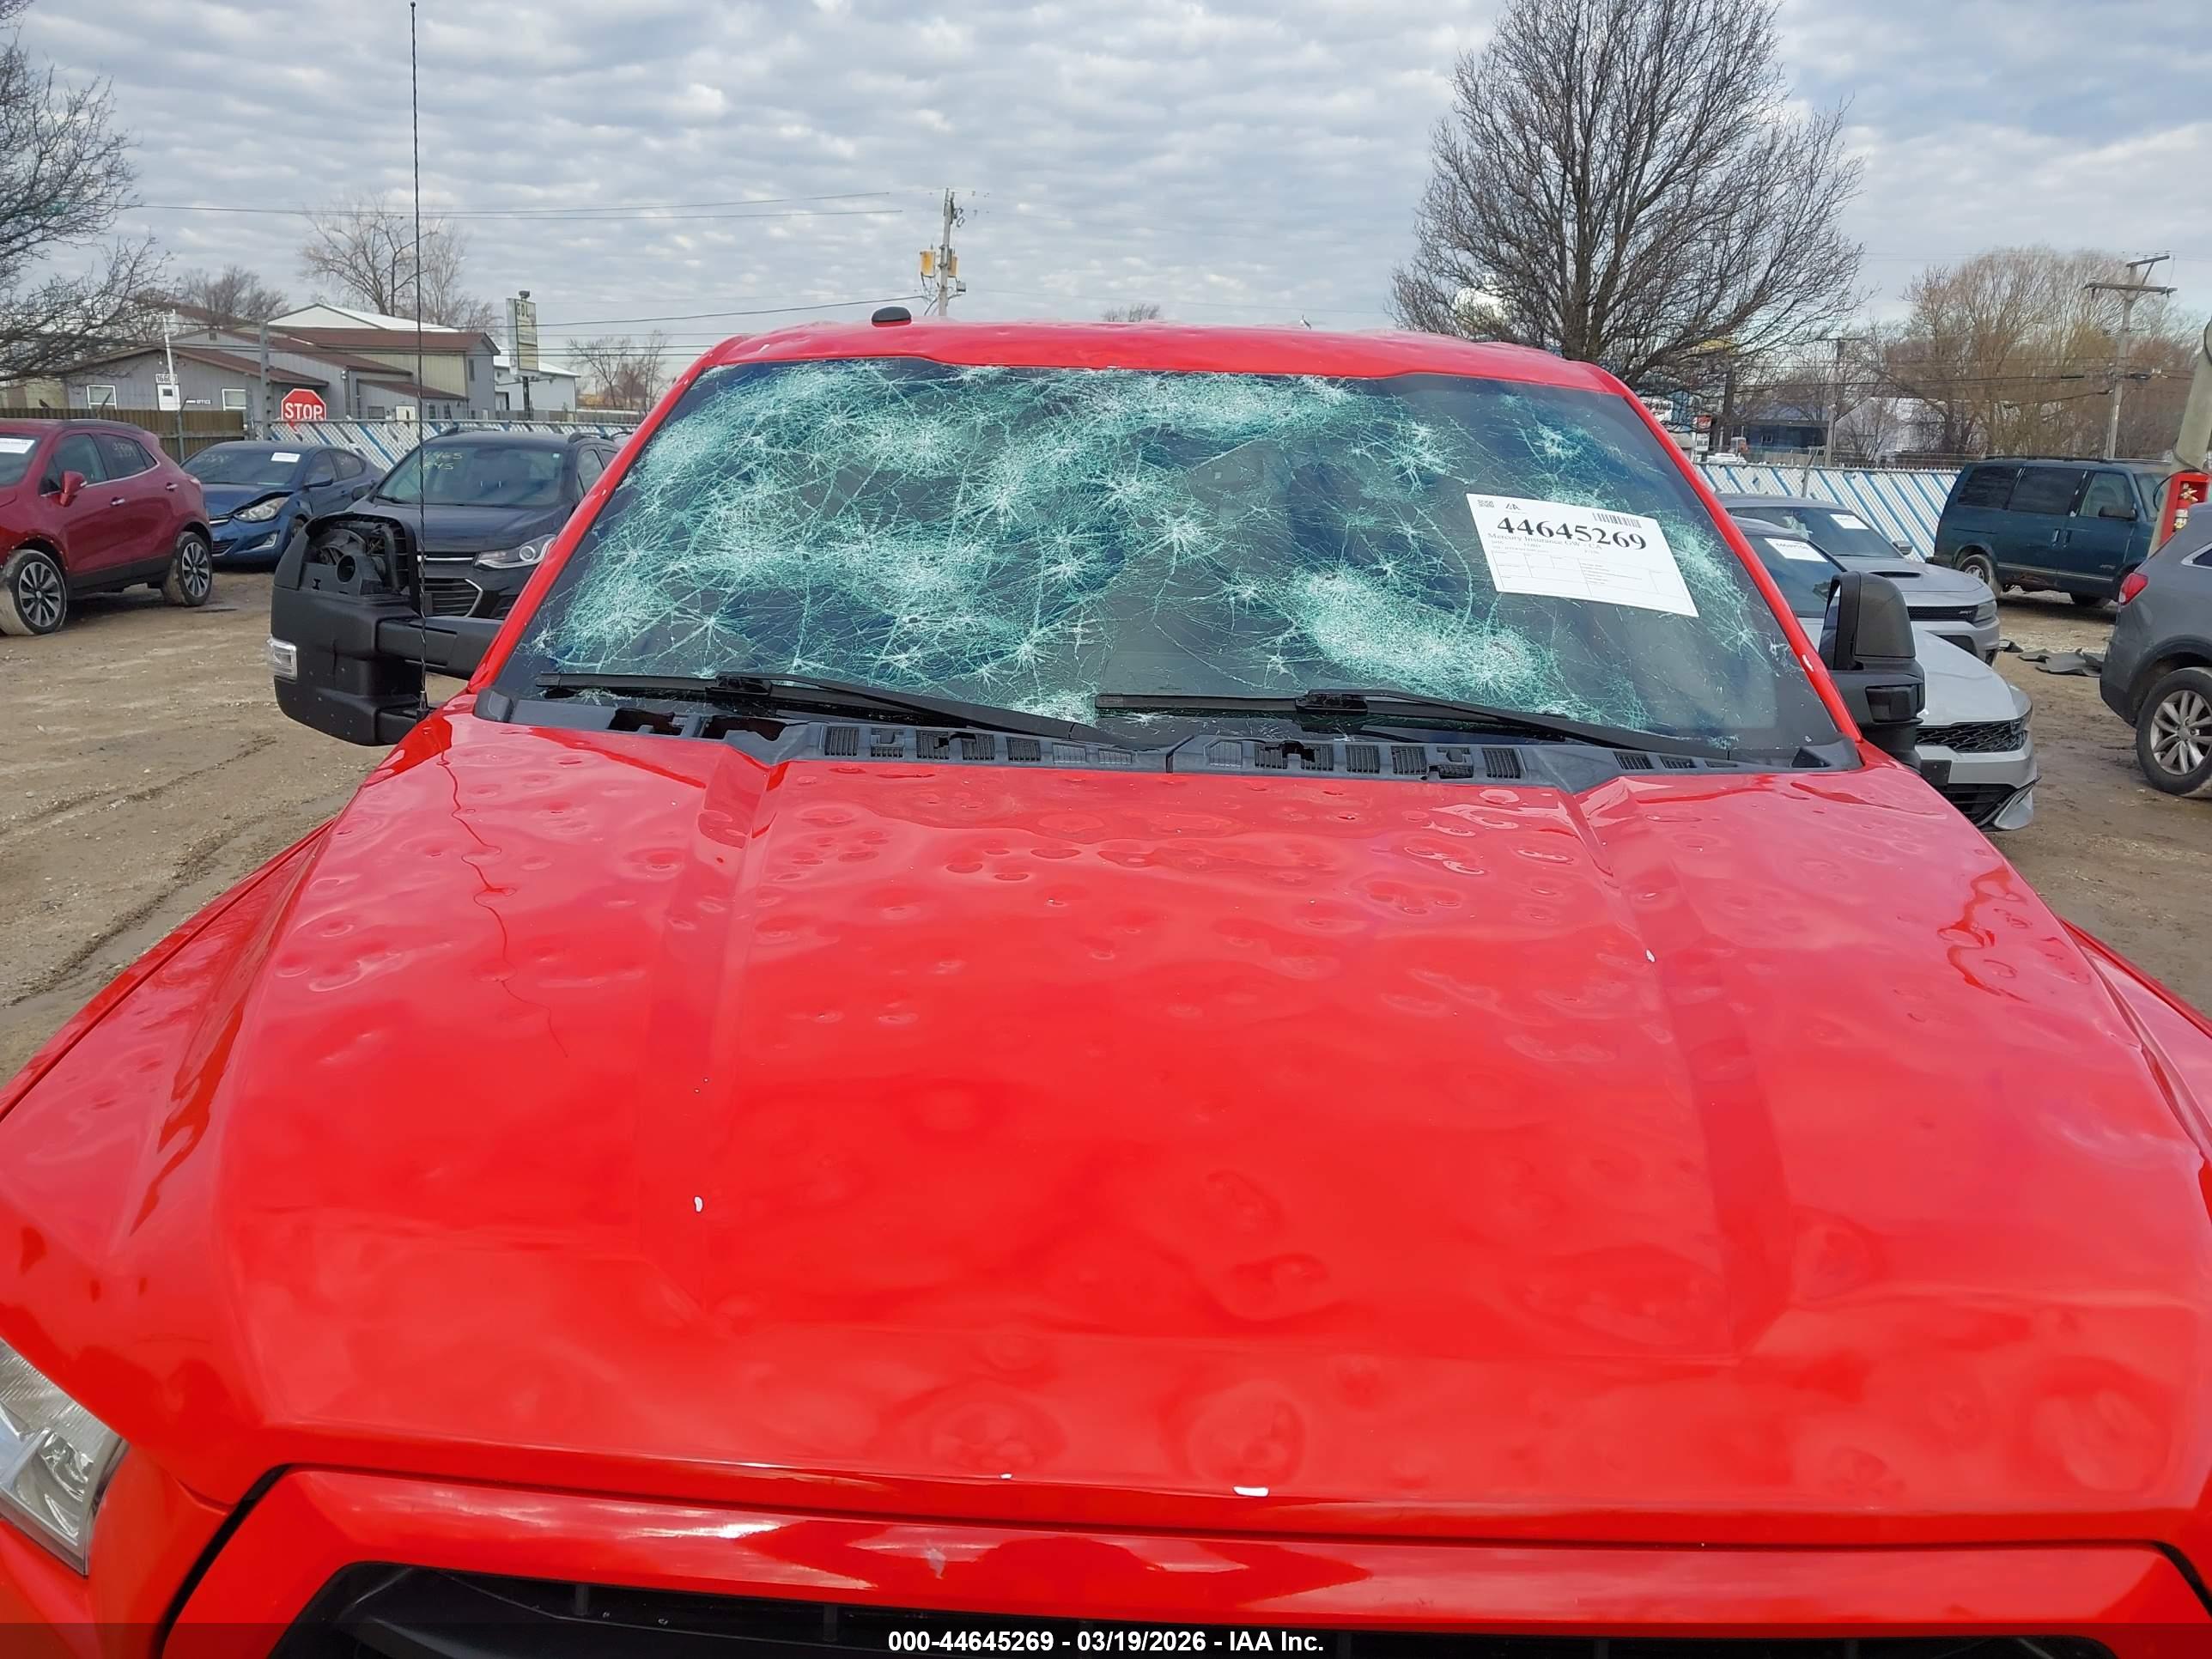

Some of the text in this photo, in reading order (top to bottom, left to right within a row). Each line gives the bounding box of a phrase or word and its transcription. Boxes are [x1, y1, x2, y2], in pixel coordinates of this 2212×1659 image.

[284, 402, 323, 420] STOP
[1487, 532, 1522, 542] Mercury
[1524, 536, 1563, 545] Insurance
[1497, 517, 1647, 550] 44645269
